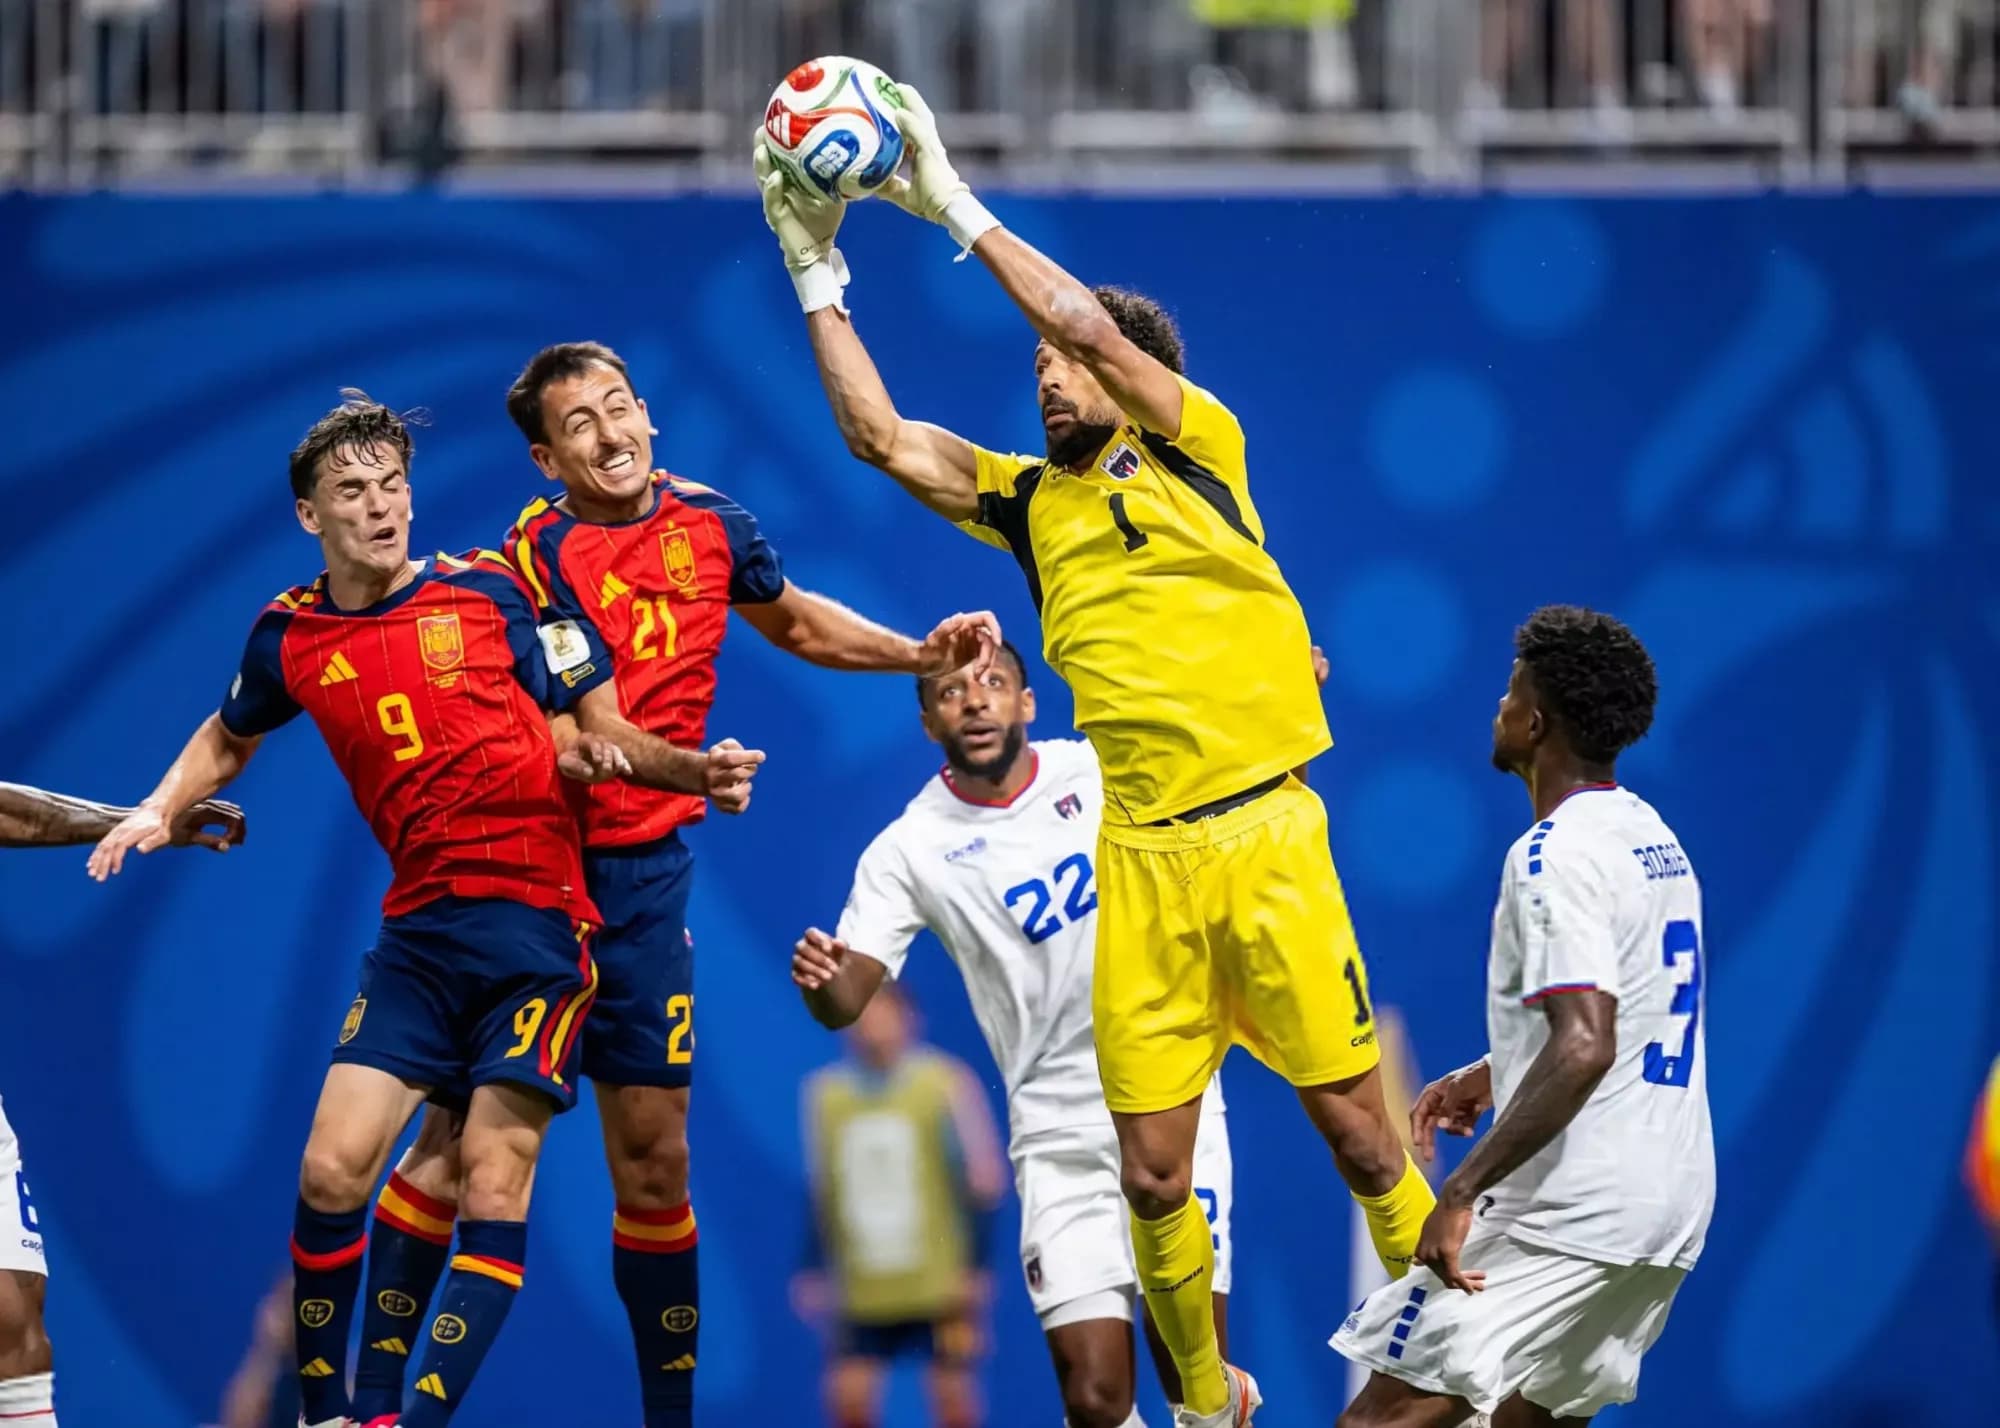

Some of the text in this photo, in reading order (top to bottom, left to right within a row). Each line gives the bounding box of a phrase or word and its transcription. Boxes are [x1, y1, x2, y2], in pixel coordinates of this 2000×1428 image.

[1109, 492, 1149, 554] 1
[632, 595, 678, 662] 21
[376, 692, 424, 762] 9
[1003, 852, 1099, 945] 22
[1343, 956, 1370, 1026] 1
[1642, 919, 1699, 1089] 3
[504, 998, 547, 1059] 9
[666, 994, 696, 1064] 2
